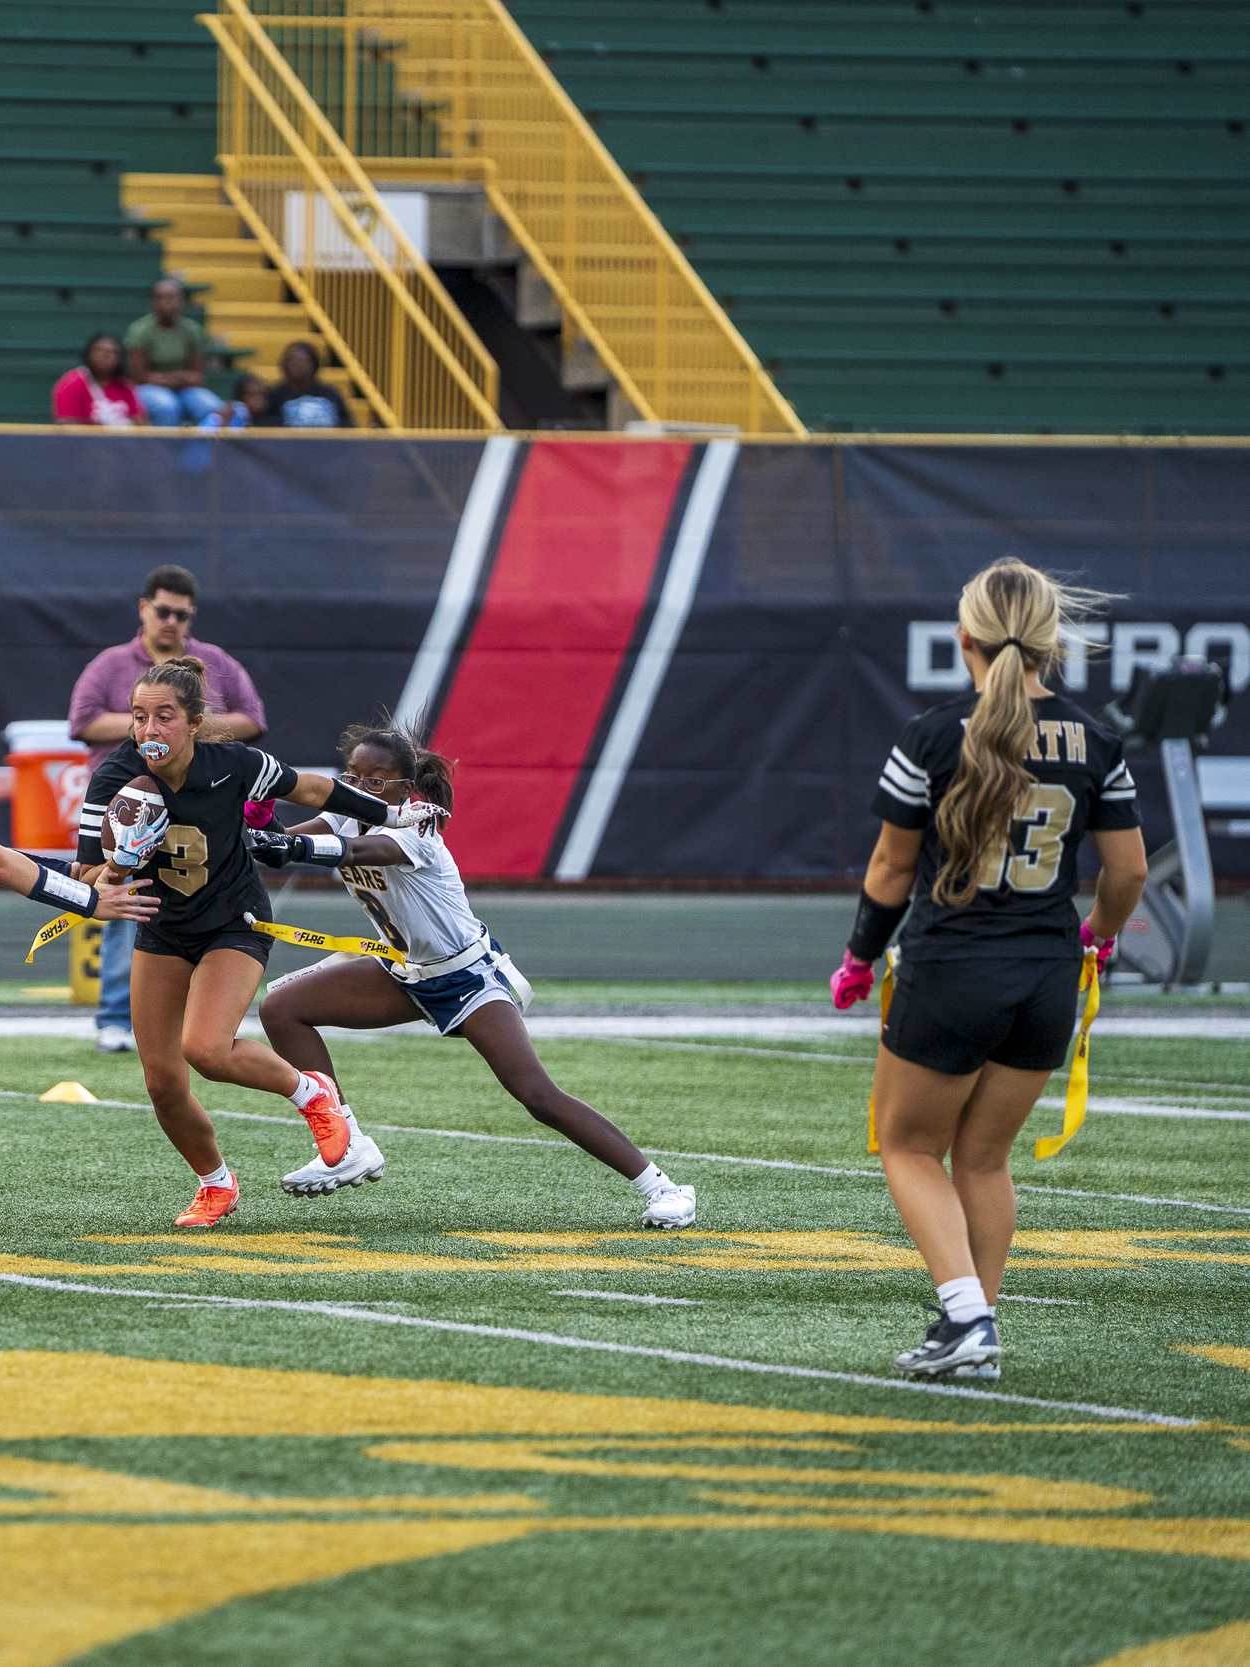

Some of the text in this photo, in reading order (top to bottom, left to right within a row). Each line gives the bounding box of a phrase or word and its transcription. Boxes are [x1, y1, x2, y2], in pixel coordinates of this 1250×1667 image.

[905, 620, 1250, 694] DTRO
[158, 824, 208, 897] 3
[40, 920, 63, 942] FLAG
[298, 931, 325, 945] FLAG
[365, 941, 388, 955] FLAG
